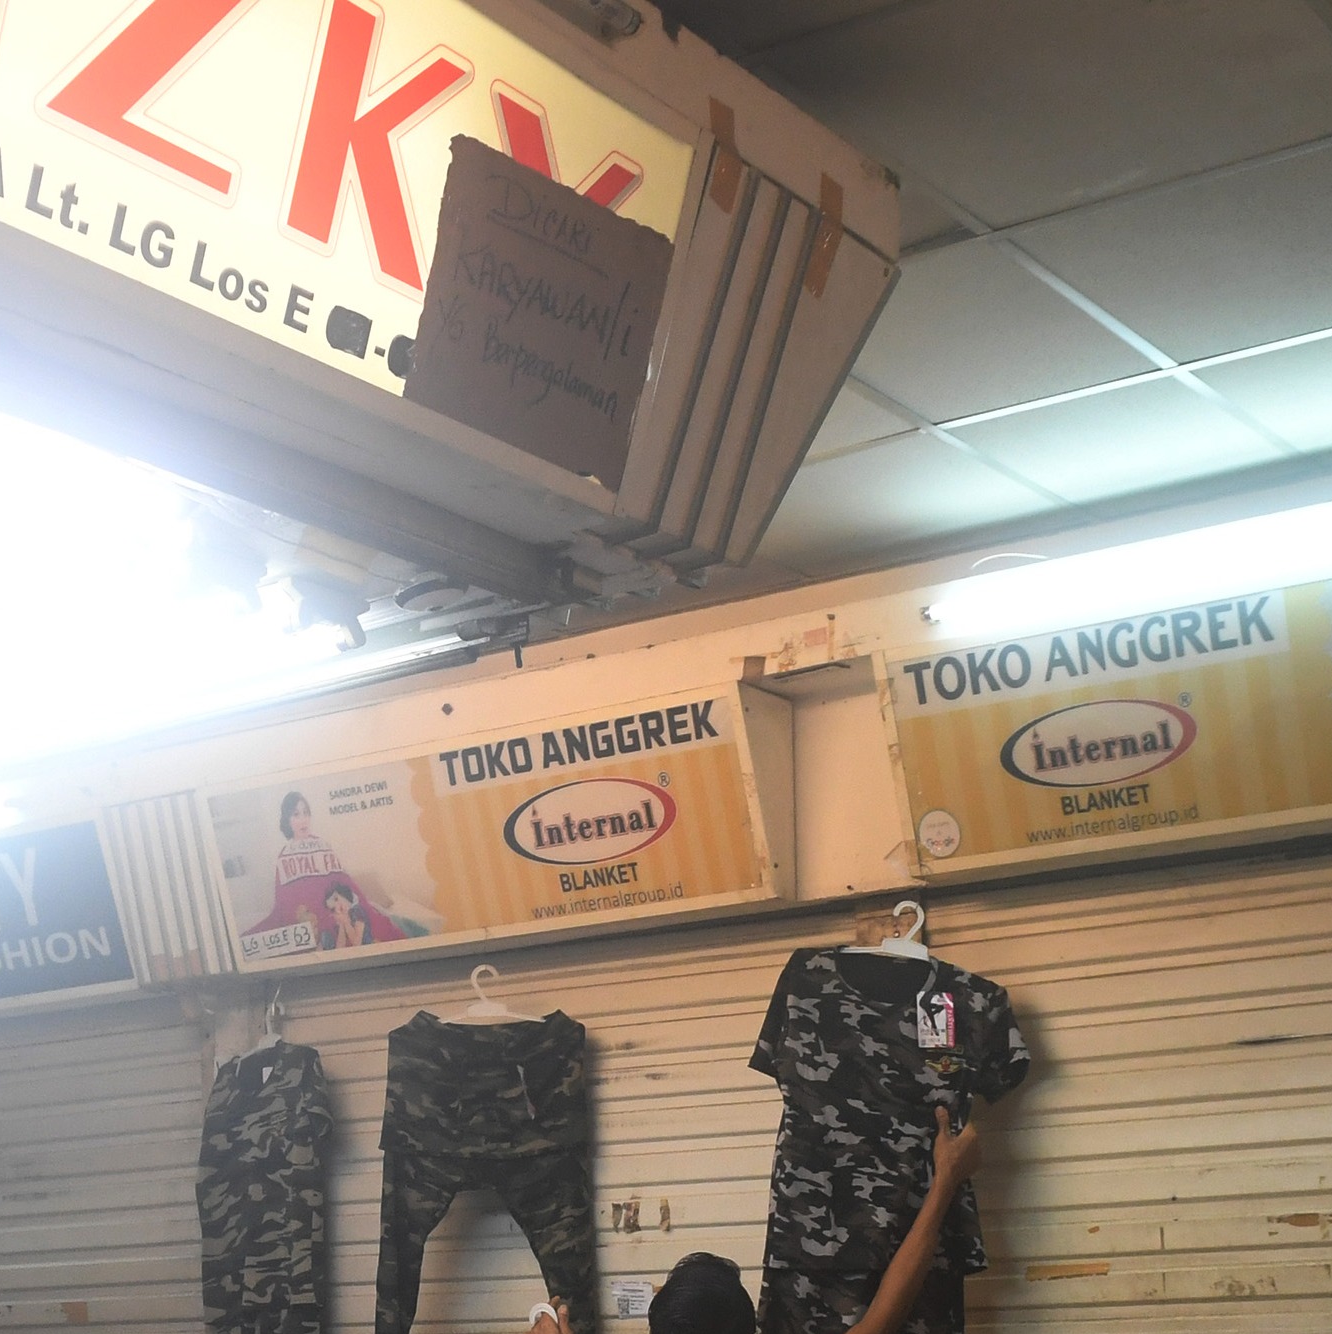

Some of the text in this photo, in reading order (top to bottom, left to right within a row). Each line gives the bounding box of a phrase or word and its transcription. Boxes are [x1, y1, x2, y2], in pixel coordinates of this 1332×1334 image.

[25, 163, 90, 236] Lt.
[108, 202, 176, 270] LG
[189, 240, 269, 315] Los
[283, 284, 315, 334] E
[903, 595, 1275, 706] TOKO ANGGREK
[439, 698, 720, 787] TOKO ANGGREK
[328, 780, 388, 801] SANDRA DEWI
[328, 796, 394, 816] MODEL & ARTIS
[1059, 783, 1151, 816] BLANKET
[1025, 804, 1199, 844] www.internalgroup.id
[281, 854, 320, 880] ROYAL
[558, 862, 639, 893] BLANKET
[531, 881, 685, 920] www.internalgroup.id
[241, 937, 259, 954] LG
[293, 925, 312, 945] 63
